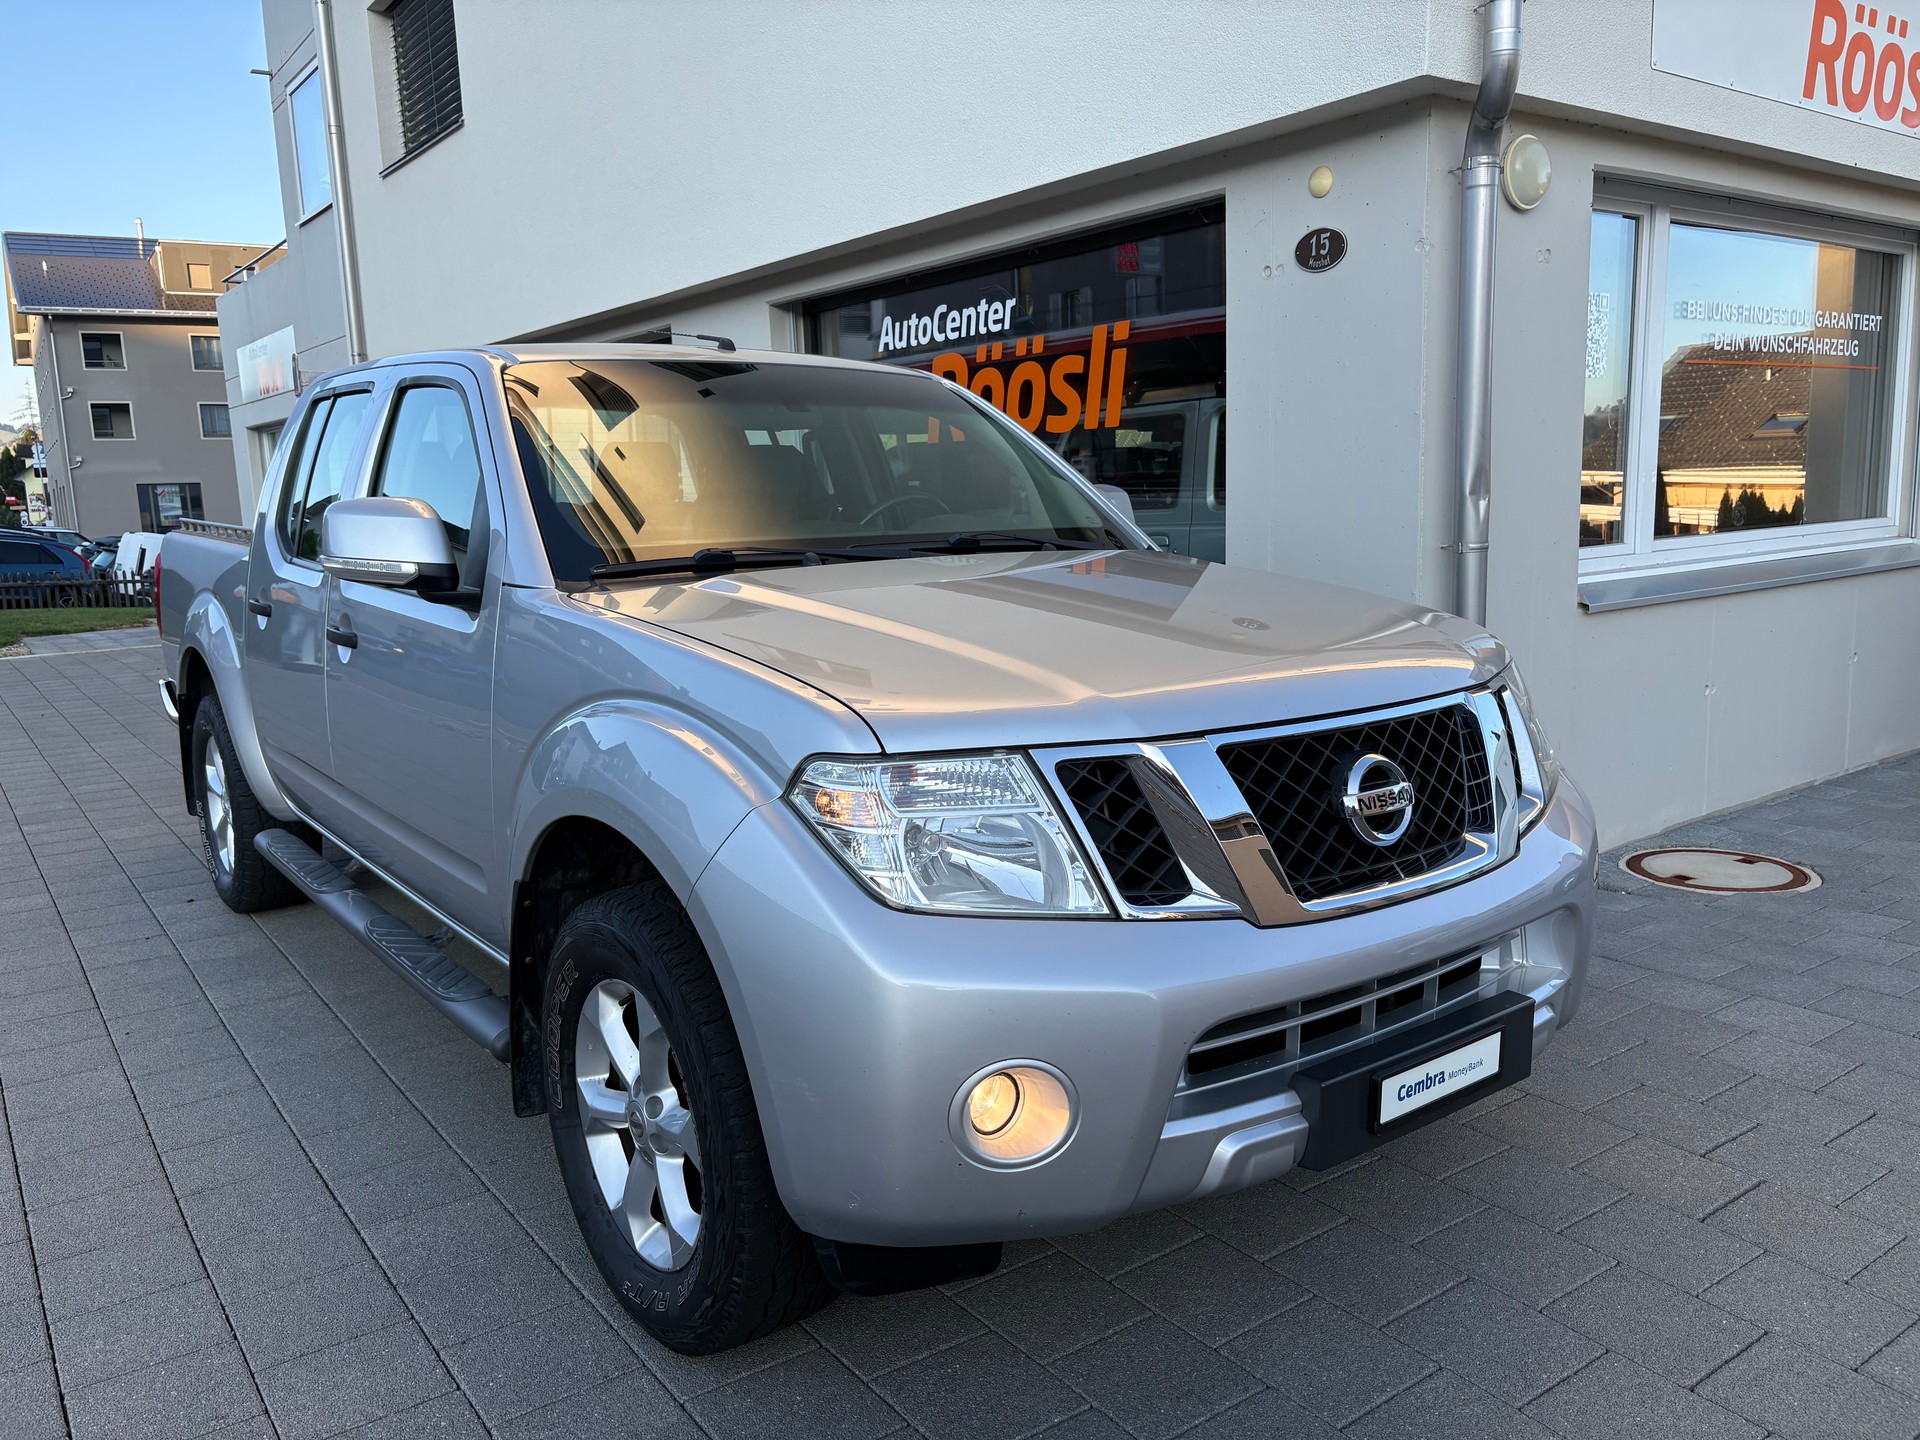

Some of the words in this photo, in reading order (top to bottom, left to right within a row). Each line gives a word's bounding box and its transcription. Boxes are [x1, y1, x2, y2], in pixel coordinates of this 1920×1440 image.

[1310, 232, 1330, 257] 15
[878, 298, 1016, 352] AutoCenter
[1713, 302, 1739, 321] UNS
[1815, 309, 1882, 332] GARANTIERT
[1714, 333, 1745, 352] DEIN
[1749, 335, 1859, 357] WUNSCHFAHRZEUG
[1359, 787, 1413, 812] NISSAN
[547, 958, 580, 1109] COOPER
[1397, 1070, 1446, 1102] Cembra
[1448, 1058, 1484, 1080] MoneyBank
